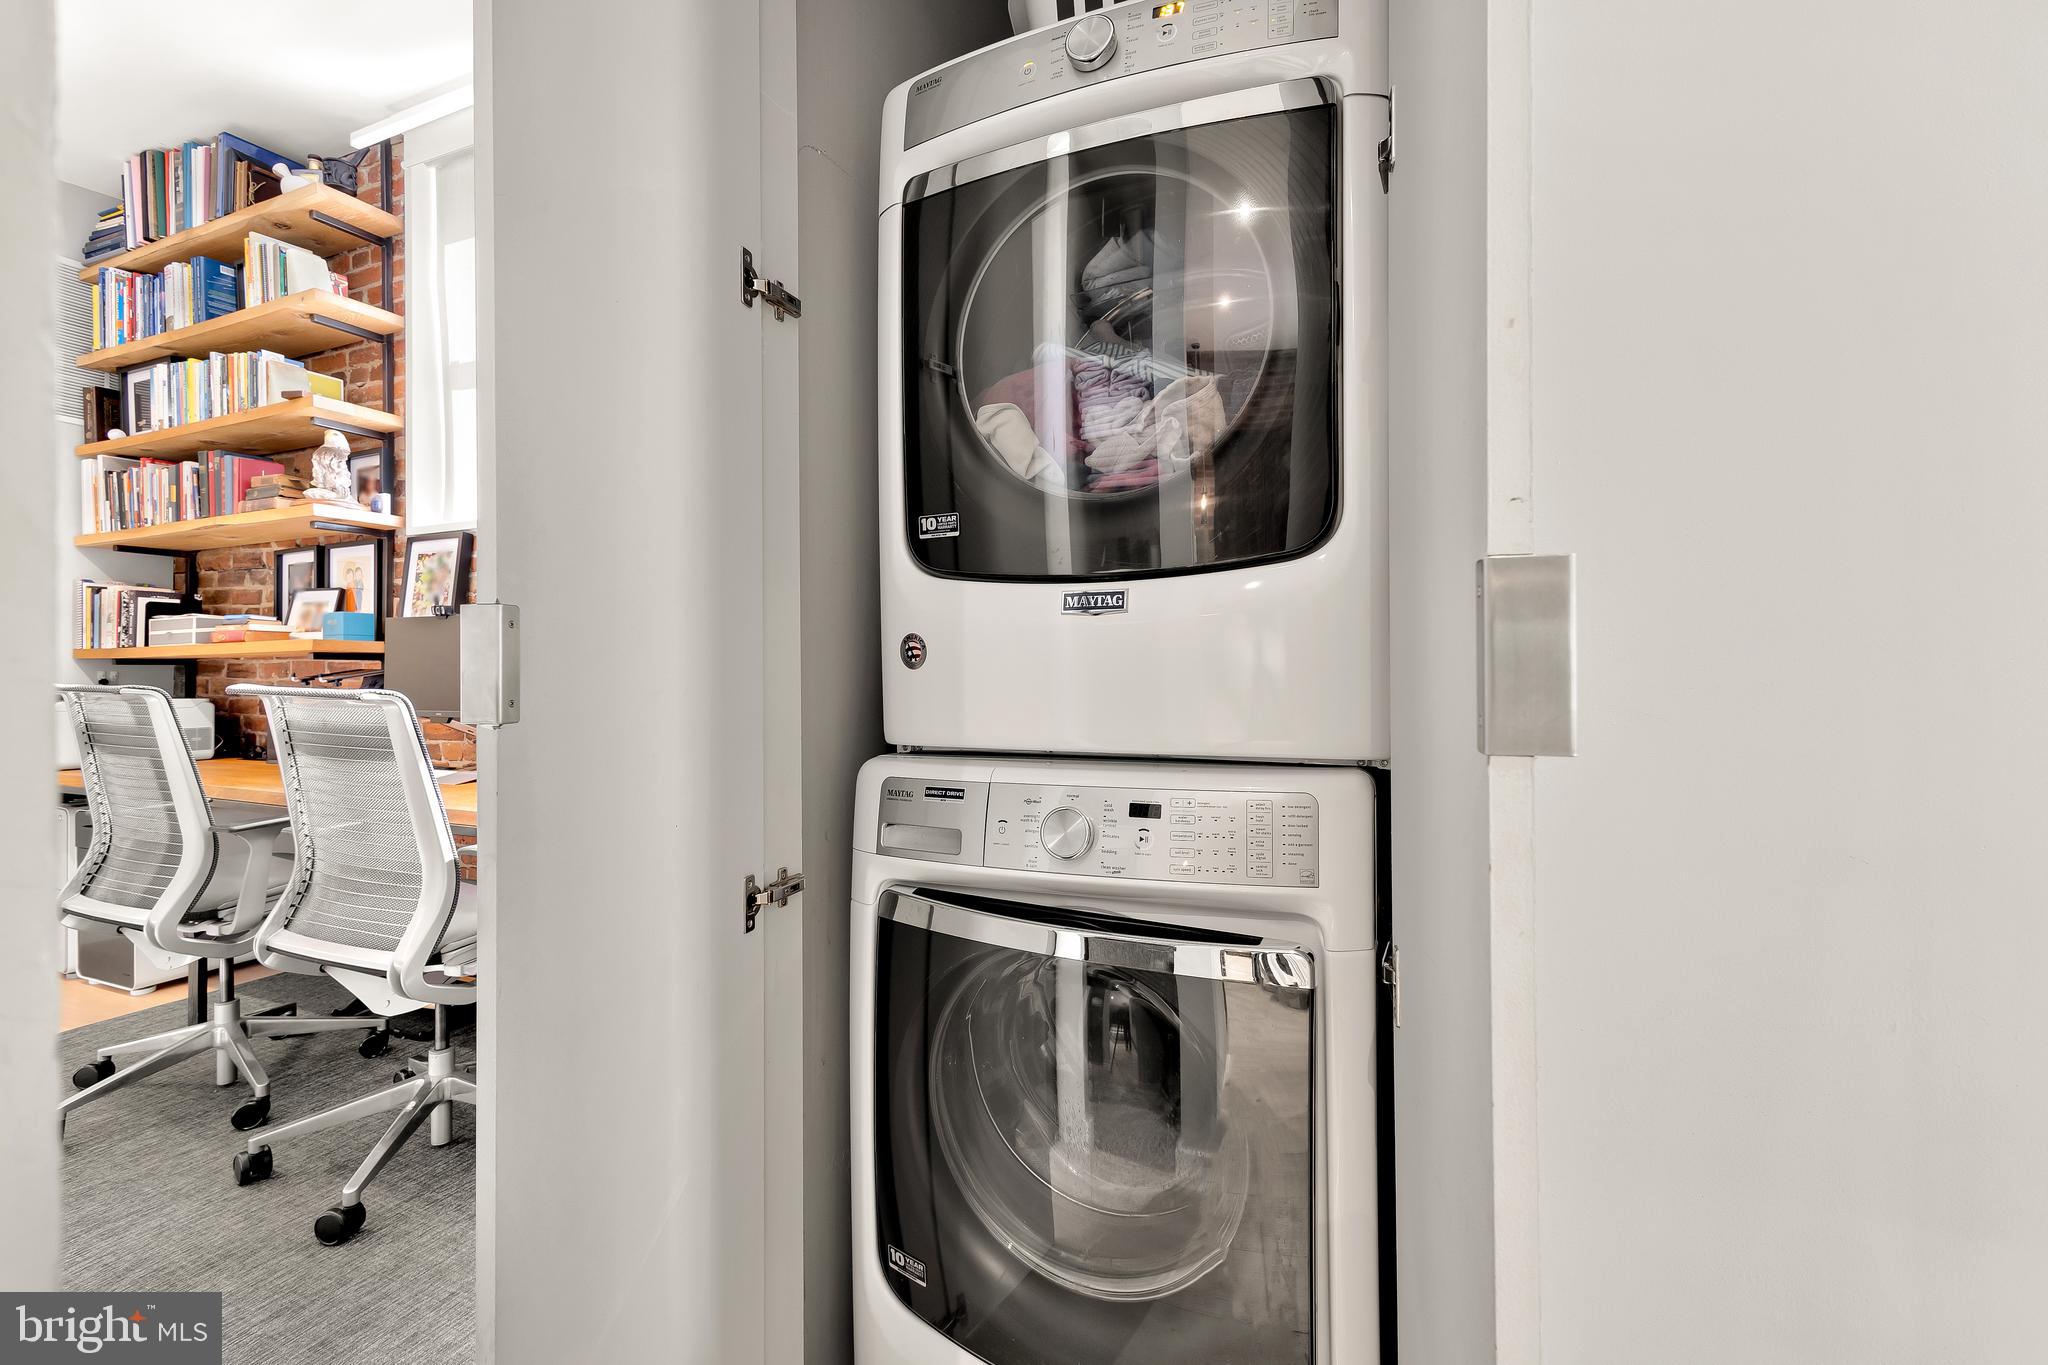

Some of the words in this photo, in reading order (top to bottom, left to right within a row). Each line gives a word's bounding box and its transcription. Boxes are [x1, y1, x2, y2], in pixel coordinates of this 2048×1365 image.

[915, 76, 943, 93] MAYTAG
[920, 517, 937, 531] 10
[1065, 594, 1123, 608] MAYTAG
[886, 789, 914, 798] MAYTAG
[890, 1248, 905, 1266] 10
[905, 1256, 924, 1272] YEAR
